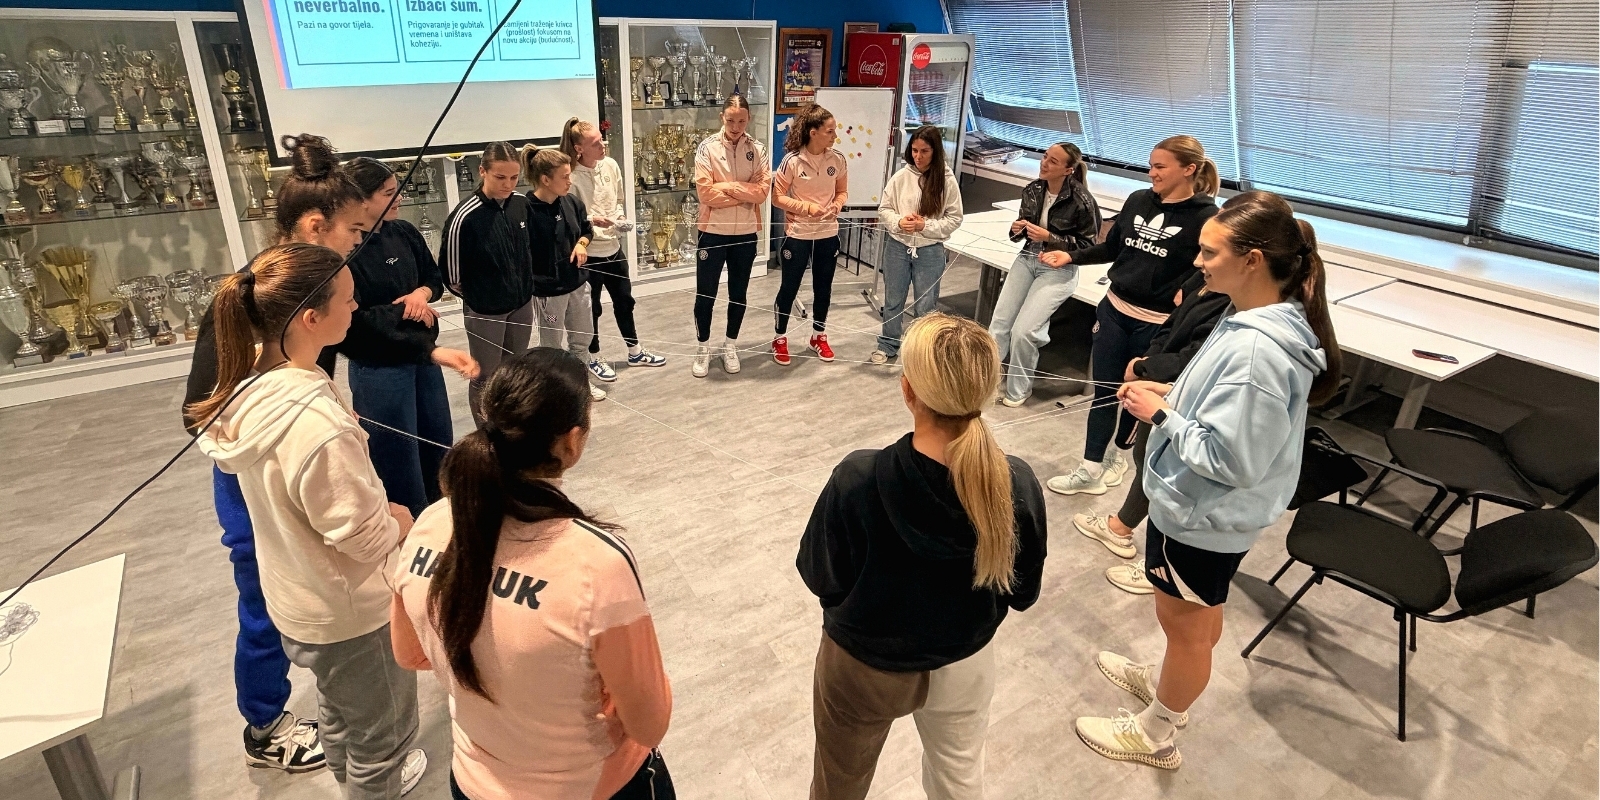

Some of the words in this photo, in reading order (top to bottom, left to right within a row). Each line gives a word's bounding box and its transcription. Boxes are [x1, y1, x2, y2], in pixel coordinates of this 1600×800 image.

[294, 0, 385, 13] neverbalno.
[297, 20, 315, 29] Pazi
[329, 22, 351, 30] govor
[352, 20, 374, 30] tijela.
[407, 20, 451, 30] Prigovaranje
[452, 21, 459, 30] je
[460, 20, 485, 30] gubitak
[530, 20, 554, 29] traženje
[444, 29, 473, 38] uništava
[505, 28, 536, 37] (prošlost)
[536, 28, 563, 36] fokusom
[410, 39, 442, 49] koheziju.
[518, 37, 537, 45] akciju
[860, 60, 886, 76] Coca-Cola
[1125, 237, 1168, 258] adidas
